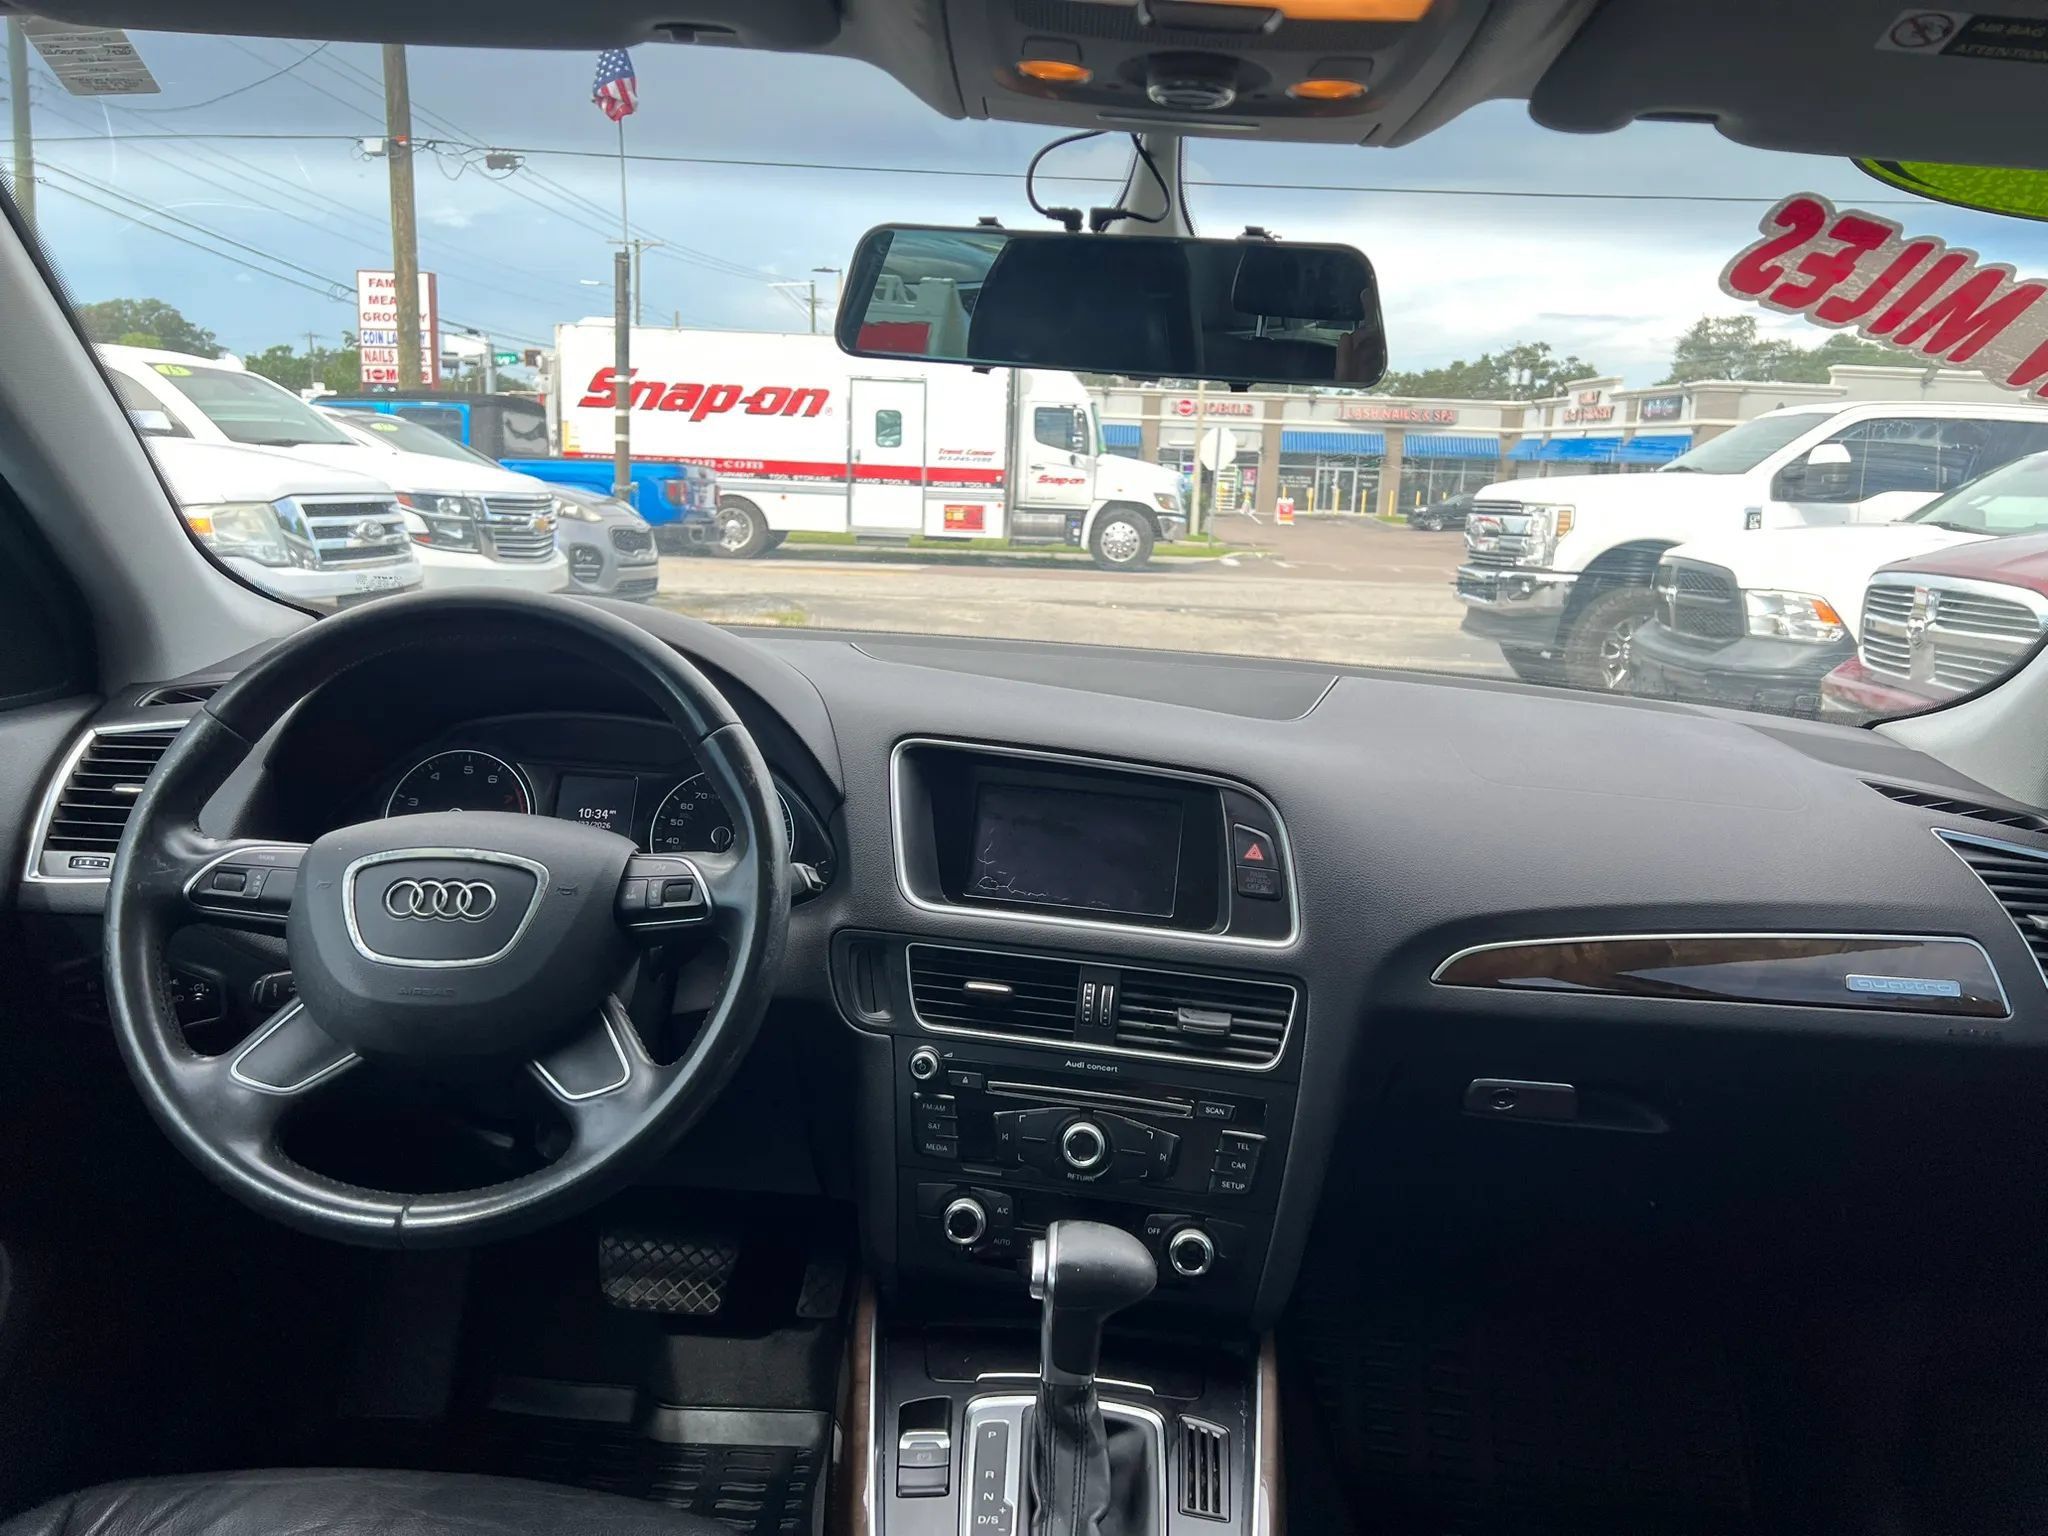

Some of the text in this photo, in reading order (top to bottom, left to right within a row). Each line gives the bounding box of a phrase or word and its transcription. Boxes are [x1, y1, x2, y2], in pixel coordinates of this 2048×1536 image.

[368, 278, 395, 288] FAM
[368, 295, 398, 305] MEA
[362, 311, 428, 322] GROCY
[363, 331, 384, 344] COIN
[364, 350, 395, 363] NAILS
[577, 366, 830, 422] Snap-on
[1036, 474, 1086, 486] Snap-on
[463, 765, 474, 775] 5
[430, 771, 440, 781] 4
[487, 774, 498, 784] 6
[694, 791, 708, 800] 70
[407, 797, 419, 807] 3
[680, 802, 694, 811] 60
[578, 807, 609, 820] 10:34
[670, 818, 684, 827] 50
[665, 837, 680, 845] 40
[1064, 1059, 1119, 1073] Audi concert
[1205, 1105, 1225, 1115] SCAN
[927, 1122, 941, 1130] SAT
[925, 1142, 948, 1152] MEDIA
[1236, 1142, 1250, 1151] TEL
[1230, 1161, 1247, 1170] CAR
[1066, 1172, 1096, 1183] RETURN
[1221, 1180, 1246, 1191] SETUP
[997, 1207, 1009, 1215] A/C
[1147, 1227, 1161, 1235] OFF
[987, 1431, 997, 1439] P
[985, 1470, 995, 1479] R
[983, 1492, 994, 1501] N
[977, 1515, 999, 1525] D/S
